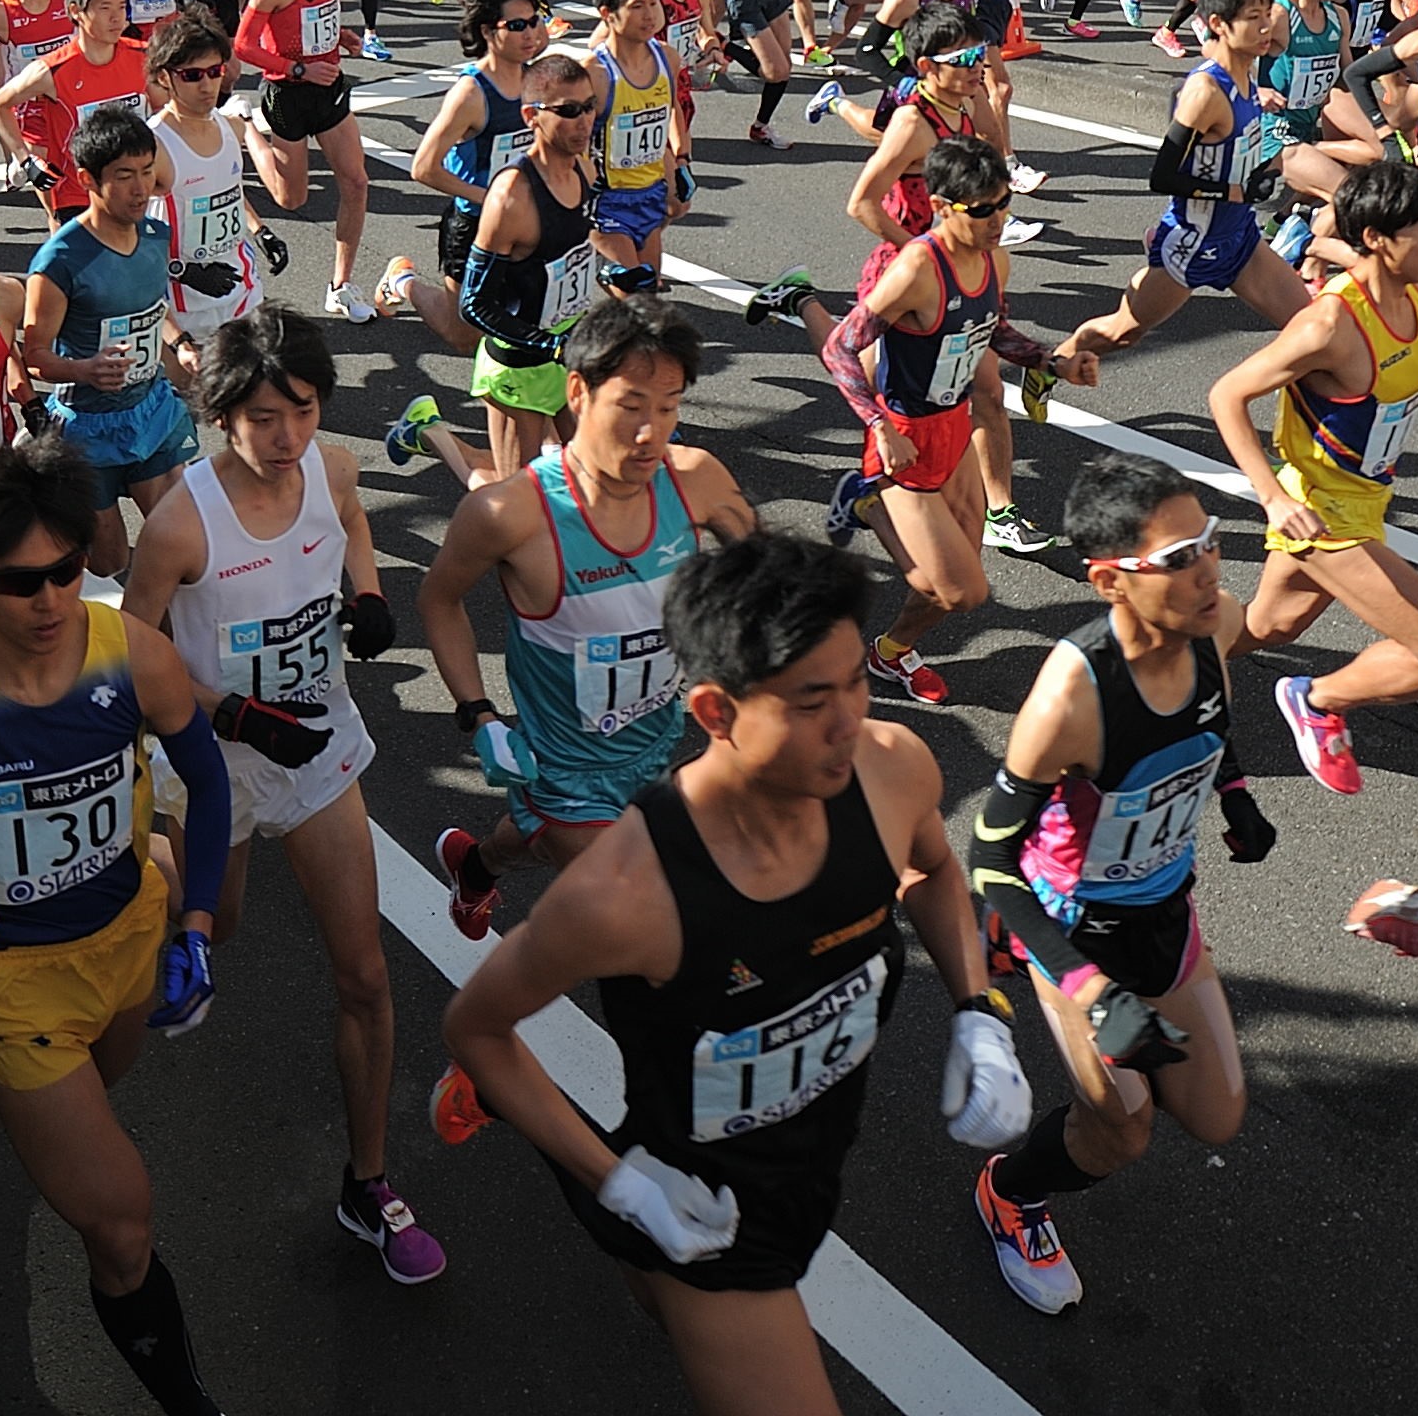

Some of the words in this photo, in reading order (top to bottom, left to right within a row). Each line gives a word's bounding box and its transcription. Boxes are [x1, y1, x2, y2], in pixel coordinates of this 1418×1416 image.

[314, 15, 338, 44] 158
[1302, 71, 1334, 98] 159
[626, 125, 663, 156] 140
[201, 206, 242, 245] 138
[557, 262, 590, 311] 137
[217, 557, 273, 580] HONDA
[575, 561, 636, 584] Yakult
[268, 600, 329, 640] 東京メトロ
[252, 625, 329, 703] 155
[31, 763, 120, 803] 東京メトロ
[13, 795, 117, 877] 130
[37, 841, 120, 897] STARTS
[768, 977, 867, 1047] 東京メトロ
[741, 1009, 852, 1111] 116
